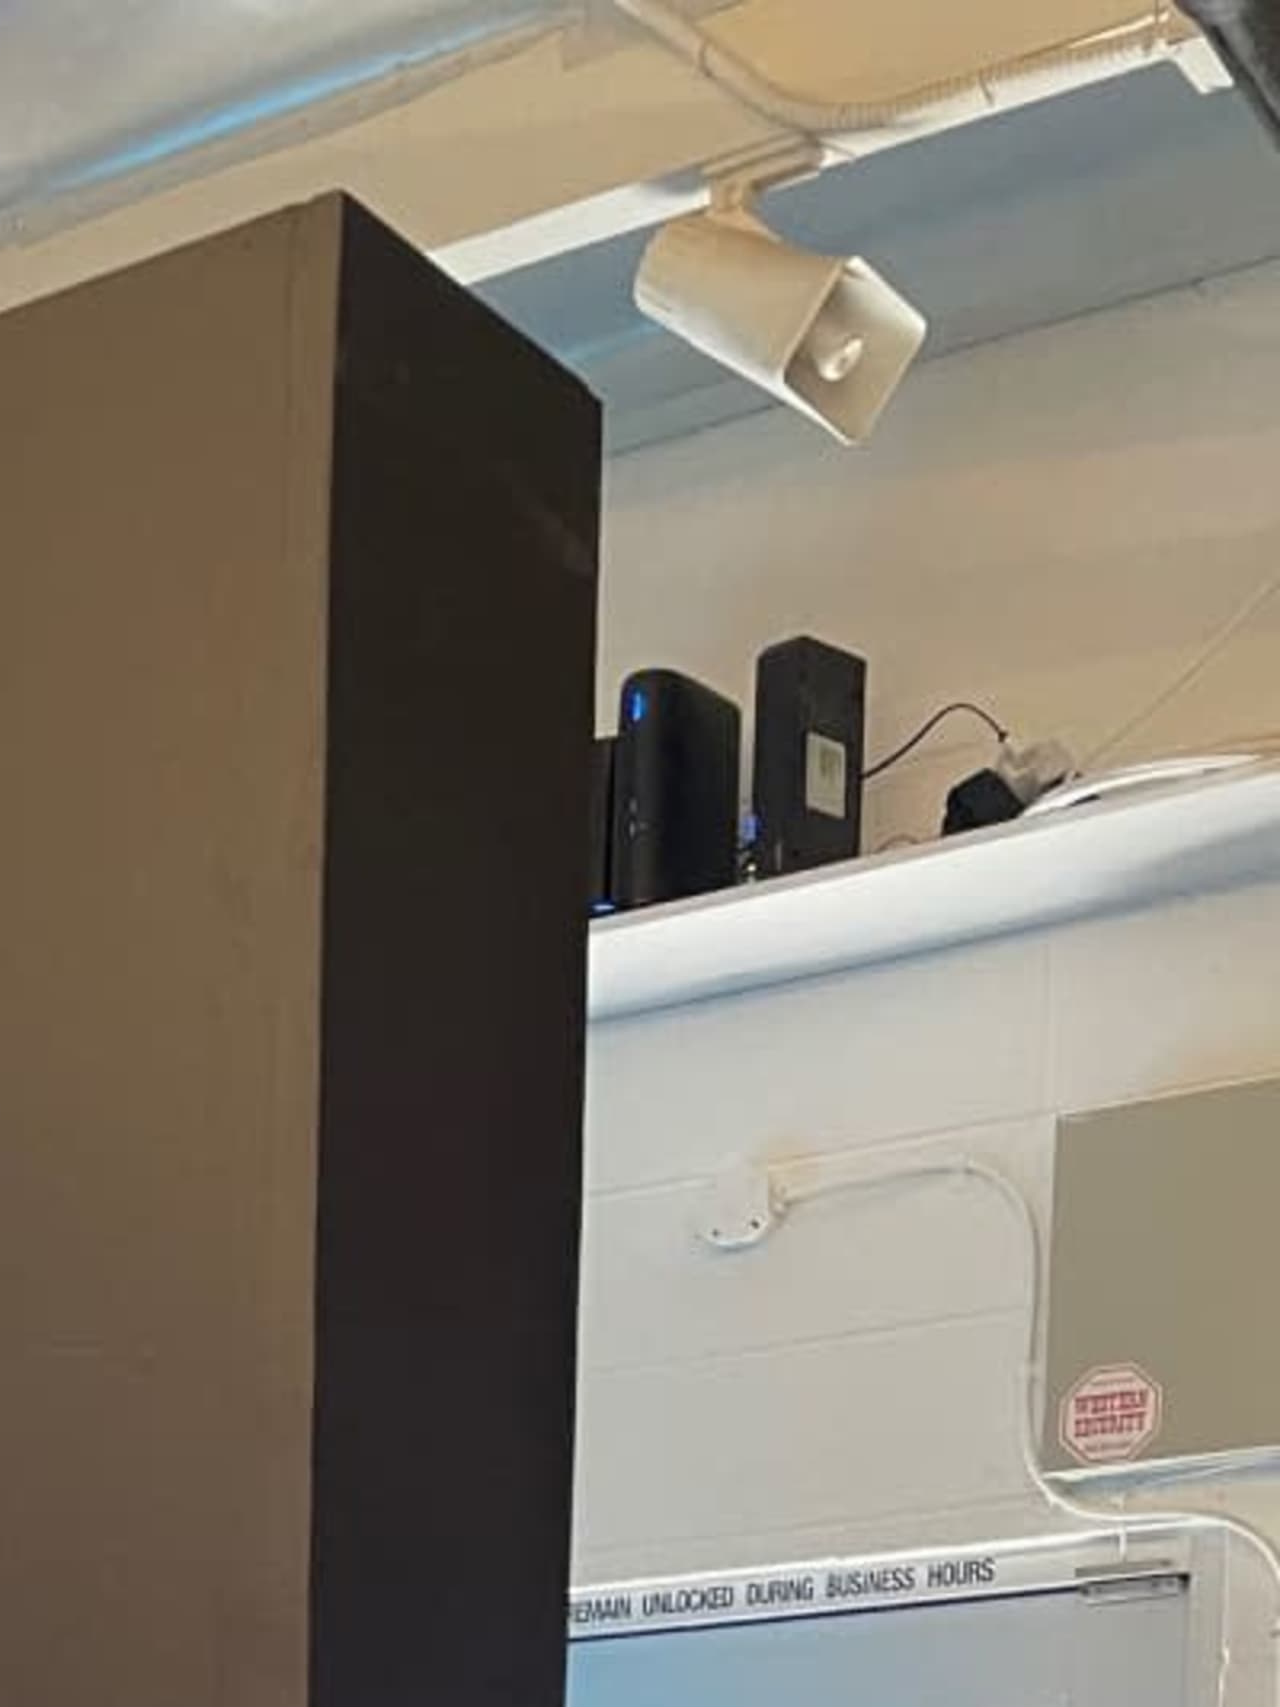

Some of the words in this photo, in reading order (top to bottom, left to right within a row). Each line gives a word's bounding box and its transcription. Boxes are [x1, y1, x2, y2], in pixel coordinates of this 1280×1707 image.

[643, 1586, 734, 1617] UNLOCKED
[746, 1576, 814, 1606] DURING
[826, 1567, 916, 1598] BUSINESS
[928, 1557, 996, 1589] HOURS
